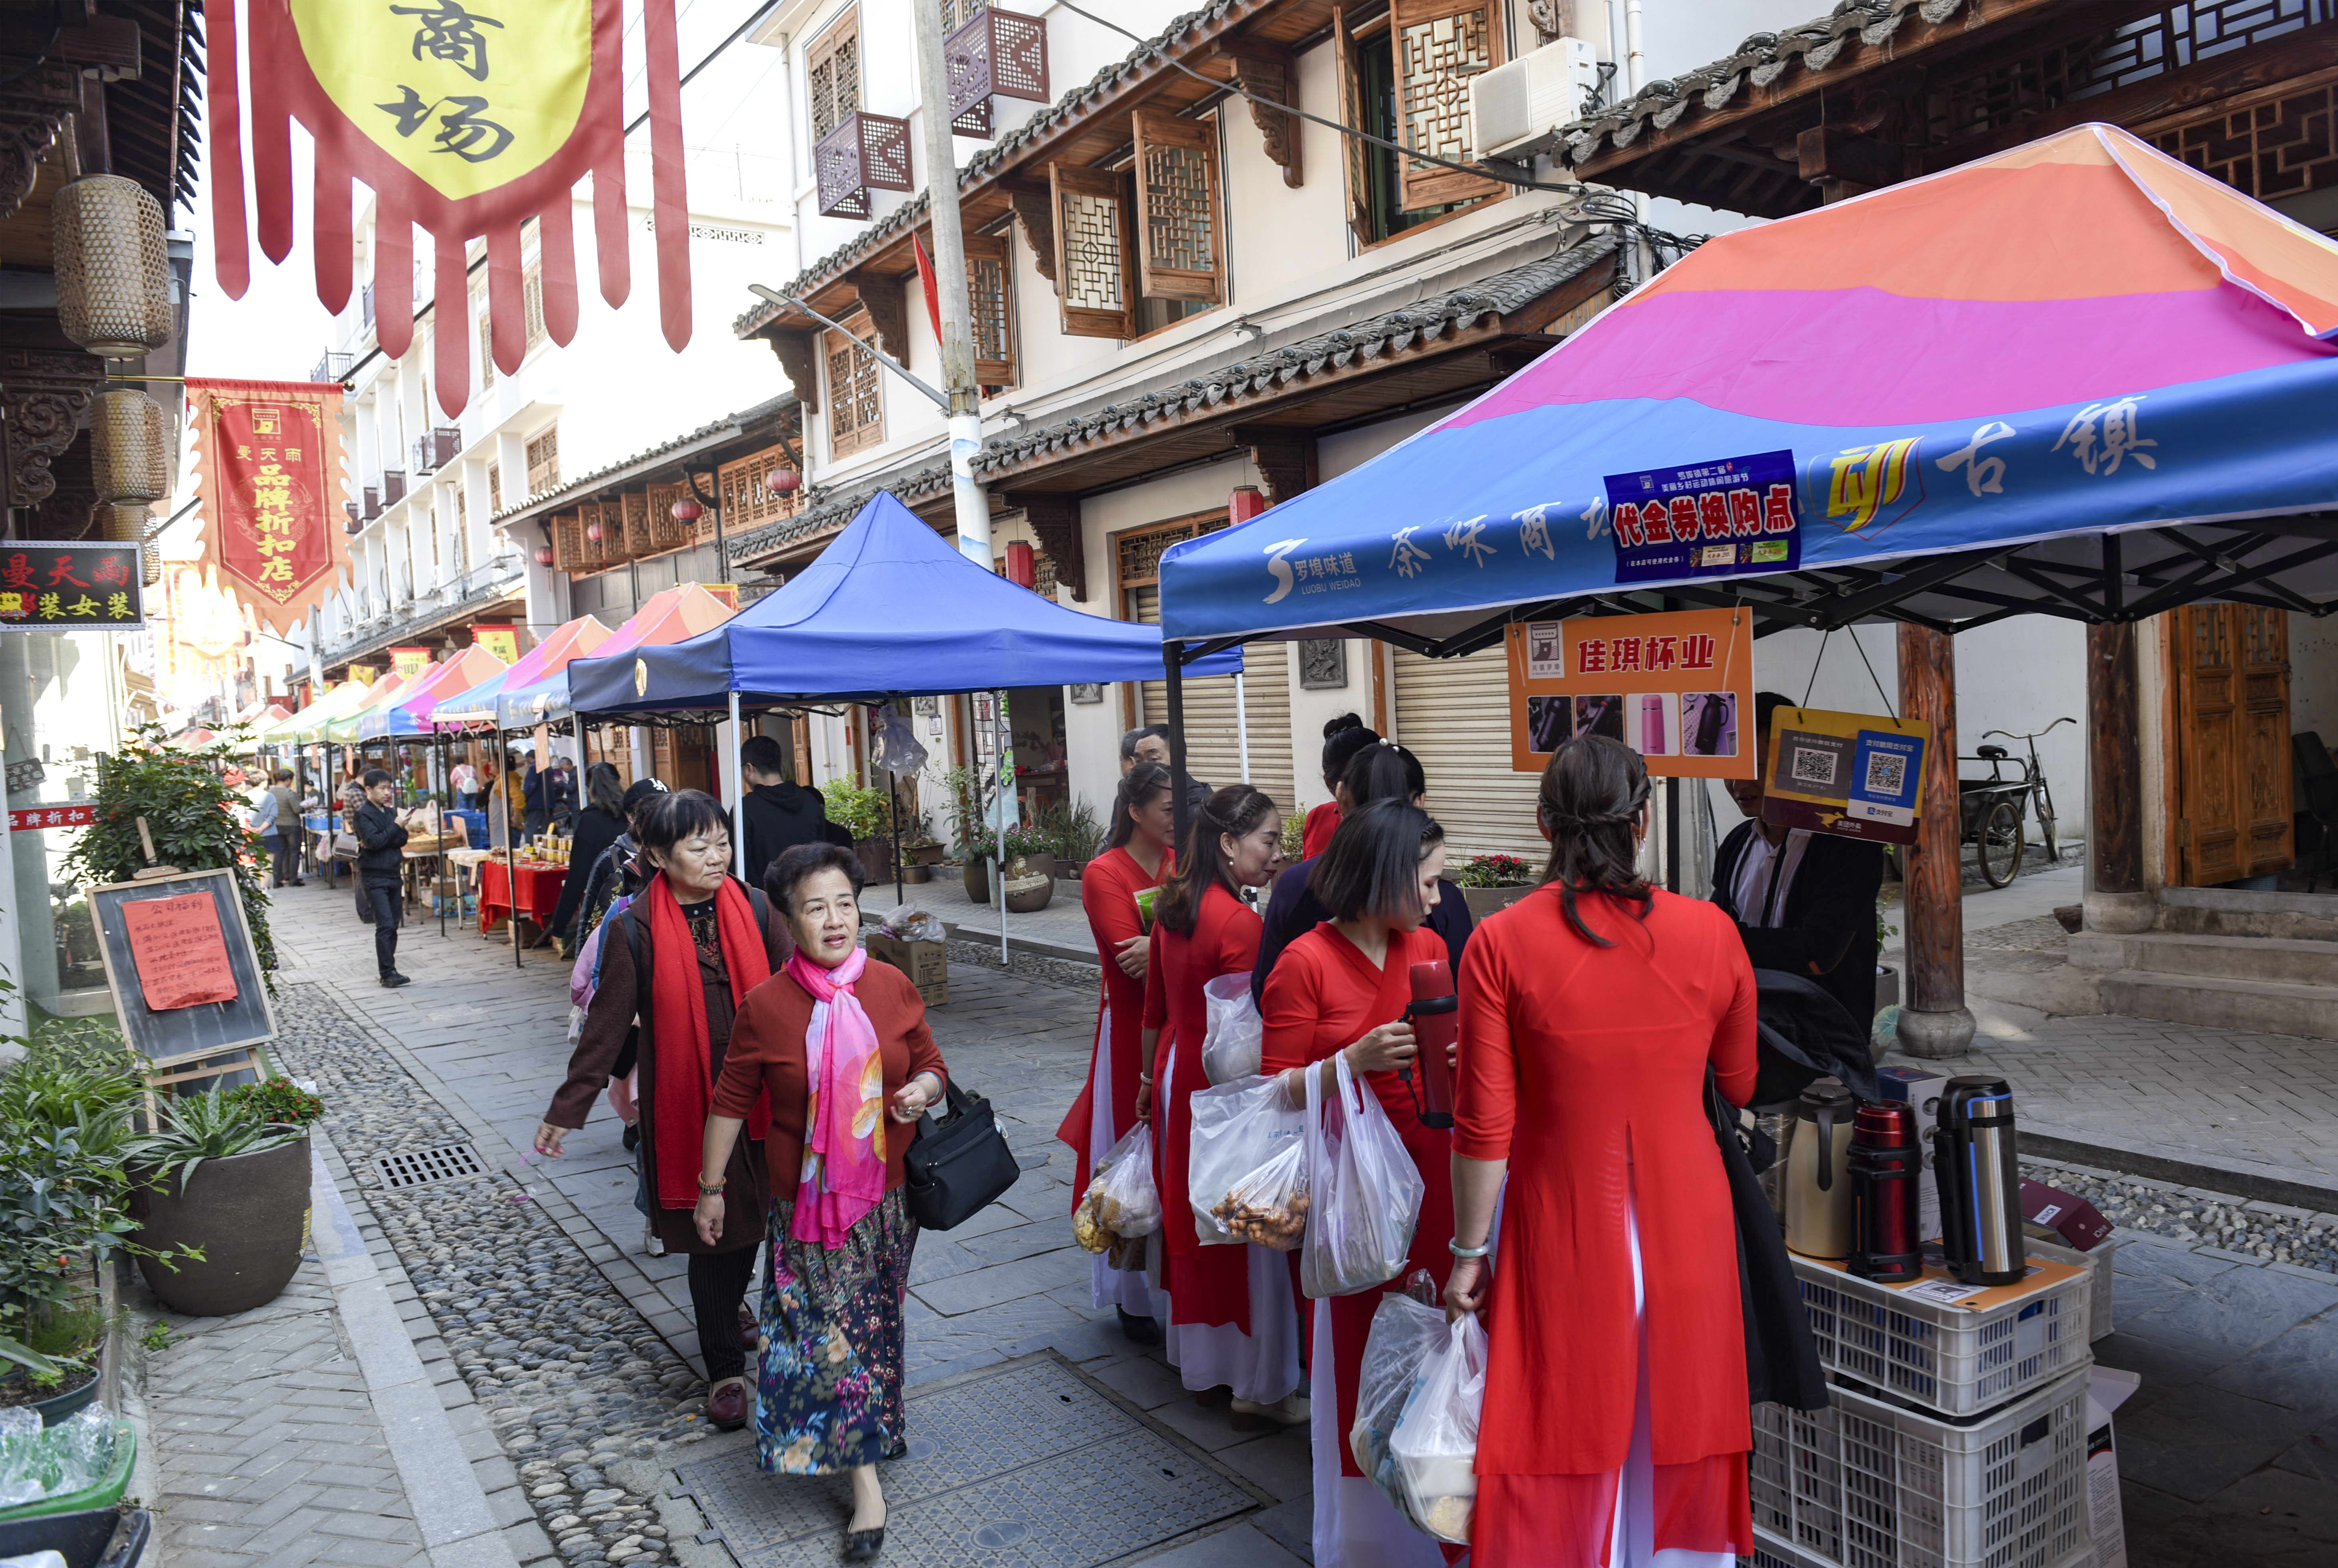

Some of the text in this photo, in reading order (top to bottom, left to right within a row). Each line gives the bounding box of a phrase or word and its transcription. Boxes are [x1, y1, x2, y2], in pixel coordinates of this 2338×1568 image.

[374, 0, 515, 163] 商场
[236, 445, 302, 462] 曼天雨
[1661, 473, 1749, 492] 美丽乡村运动休闲旅游节
[252, 464, 297, 582] 品牌折扣店
[1613, 484, 1796, 547] 代金券换购点
[1, 553, 131, 589] 曼天雨
[1295, 551, 1357, 581] 罗埠味道
[1301, 578, 1361, 594] LUOBU WEIDAO
[1578, 633, 1716, 674] 佳琪杯业
[648, 778, 668, 792] LA
[151, 899, 202, 915] 公司福利
